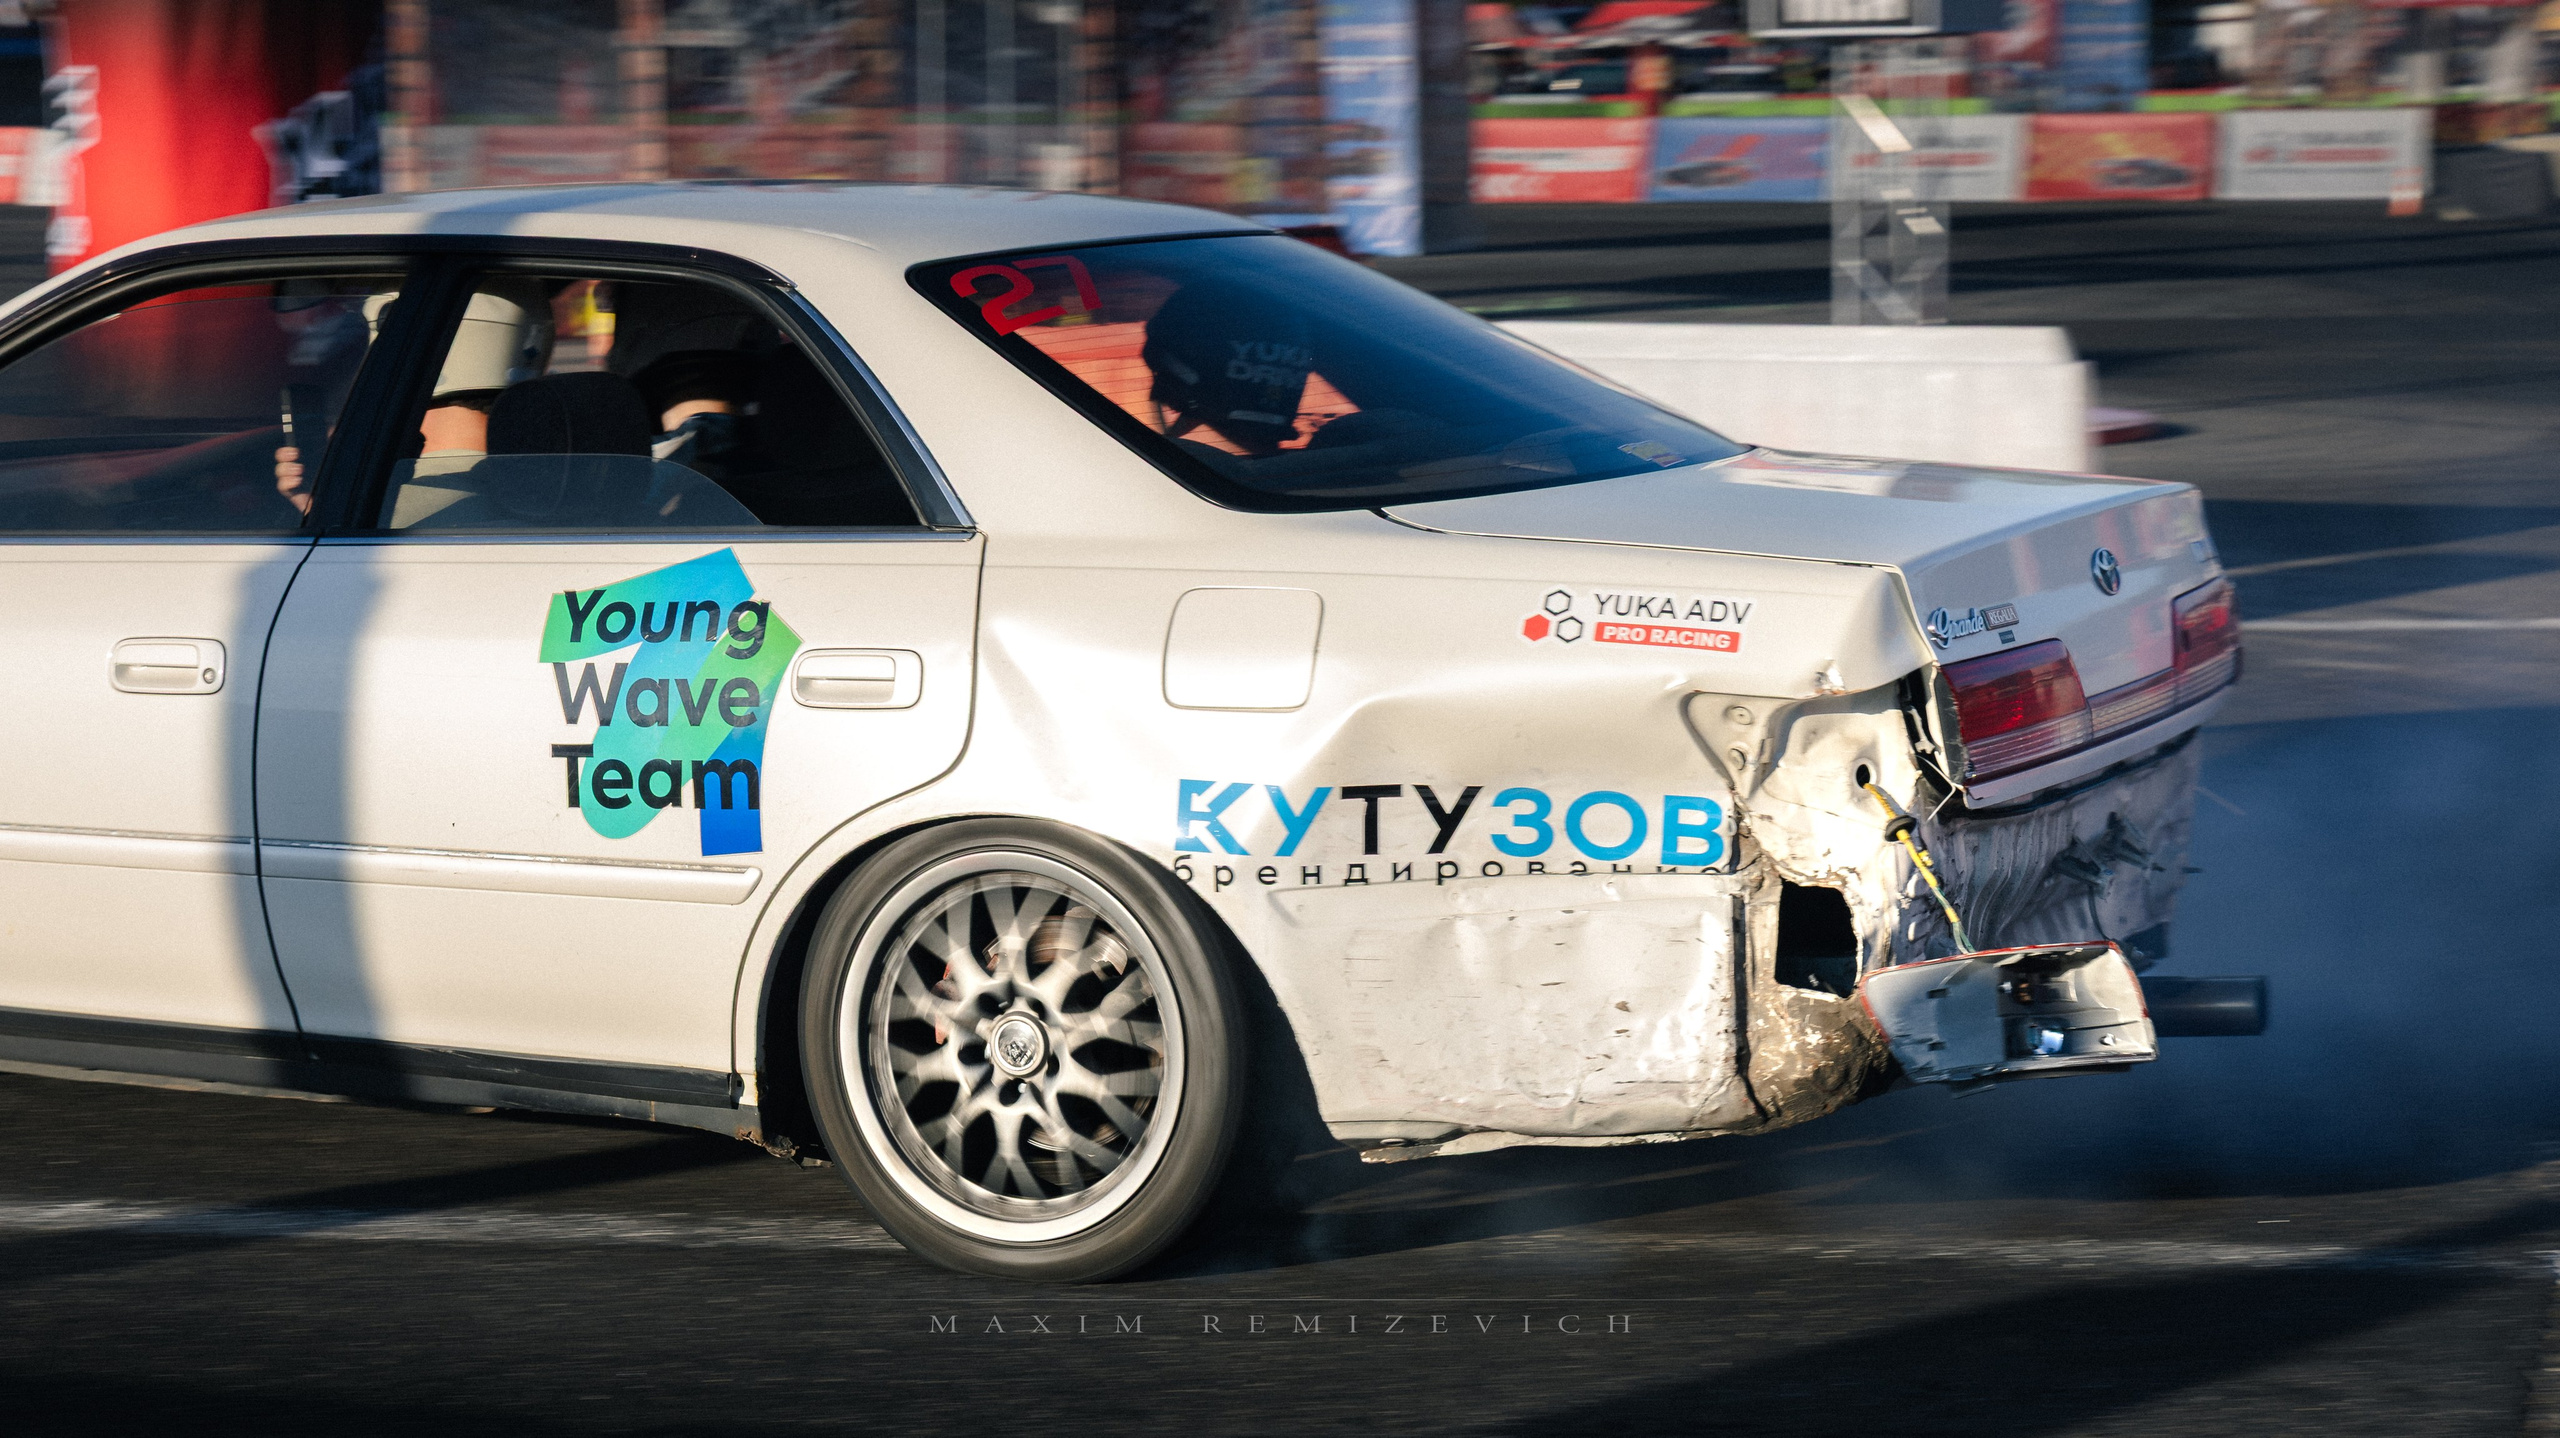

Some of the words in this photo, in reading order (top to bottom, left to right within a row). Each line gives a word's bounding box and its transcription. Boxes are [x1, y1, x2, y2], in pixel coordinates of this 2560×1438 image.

[950, 255, 1103, 336] 27
[564, 590, 770, 660] Young
[1594, 593, 1676, 619] YUKA
[1685, 599, 1752, 625] ADV
[1602, 625, 1646, 643] PRO
[1650, 628, 1731, 649] RACING
[1927, 607, 1984, 649] Grande
[553, 662, 760, 727] Wave
[551, 744, 759, 809] Team
[1174, 778, 1726, 867] КУТУЗОВ
